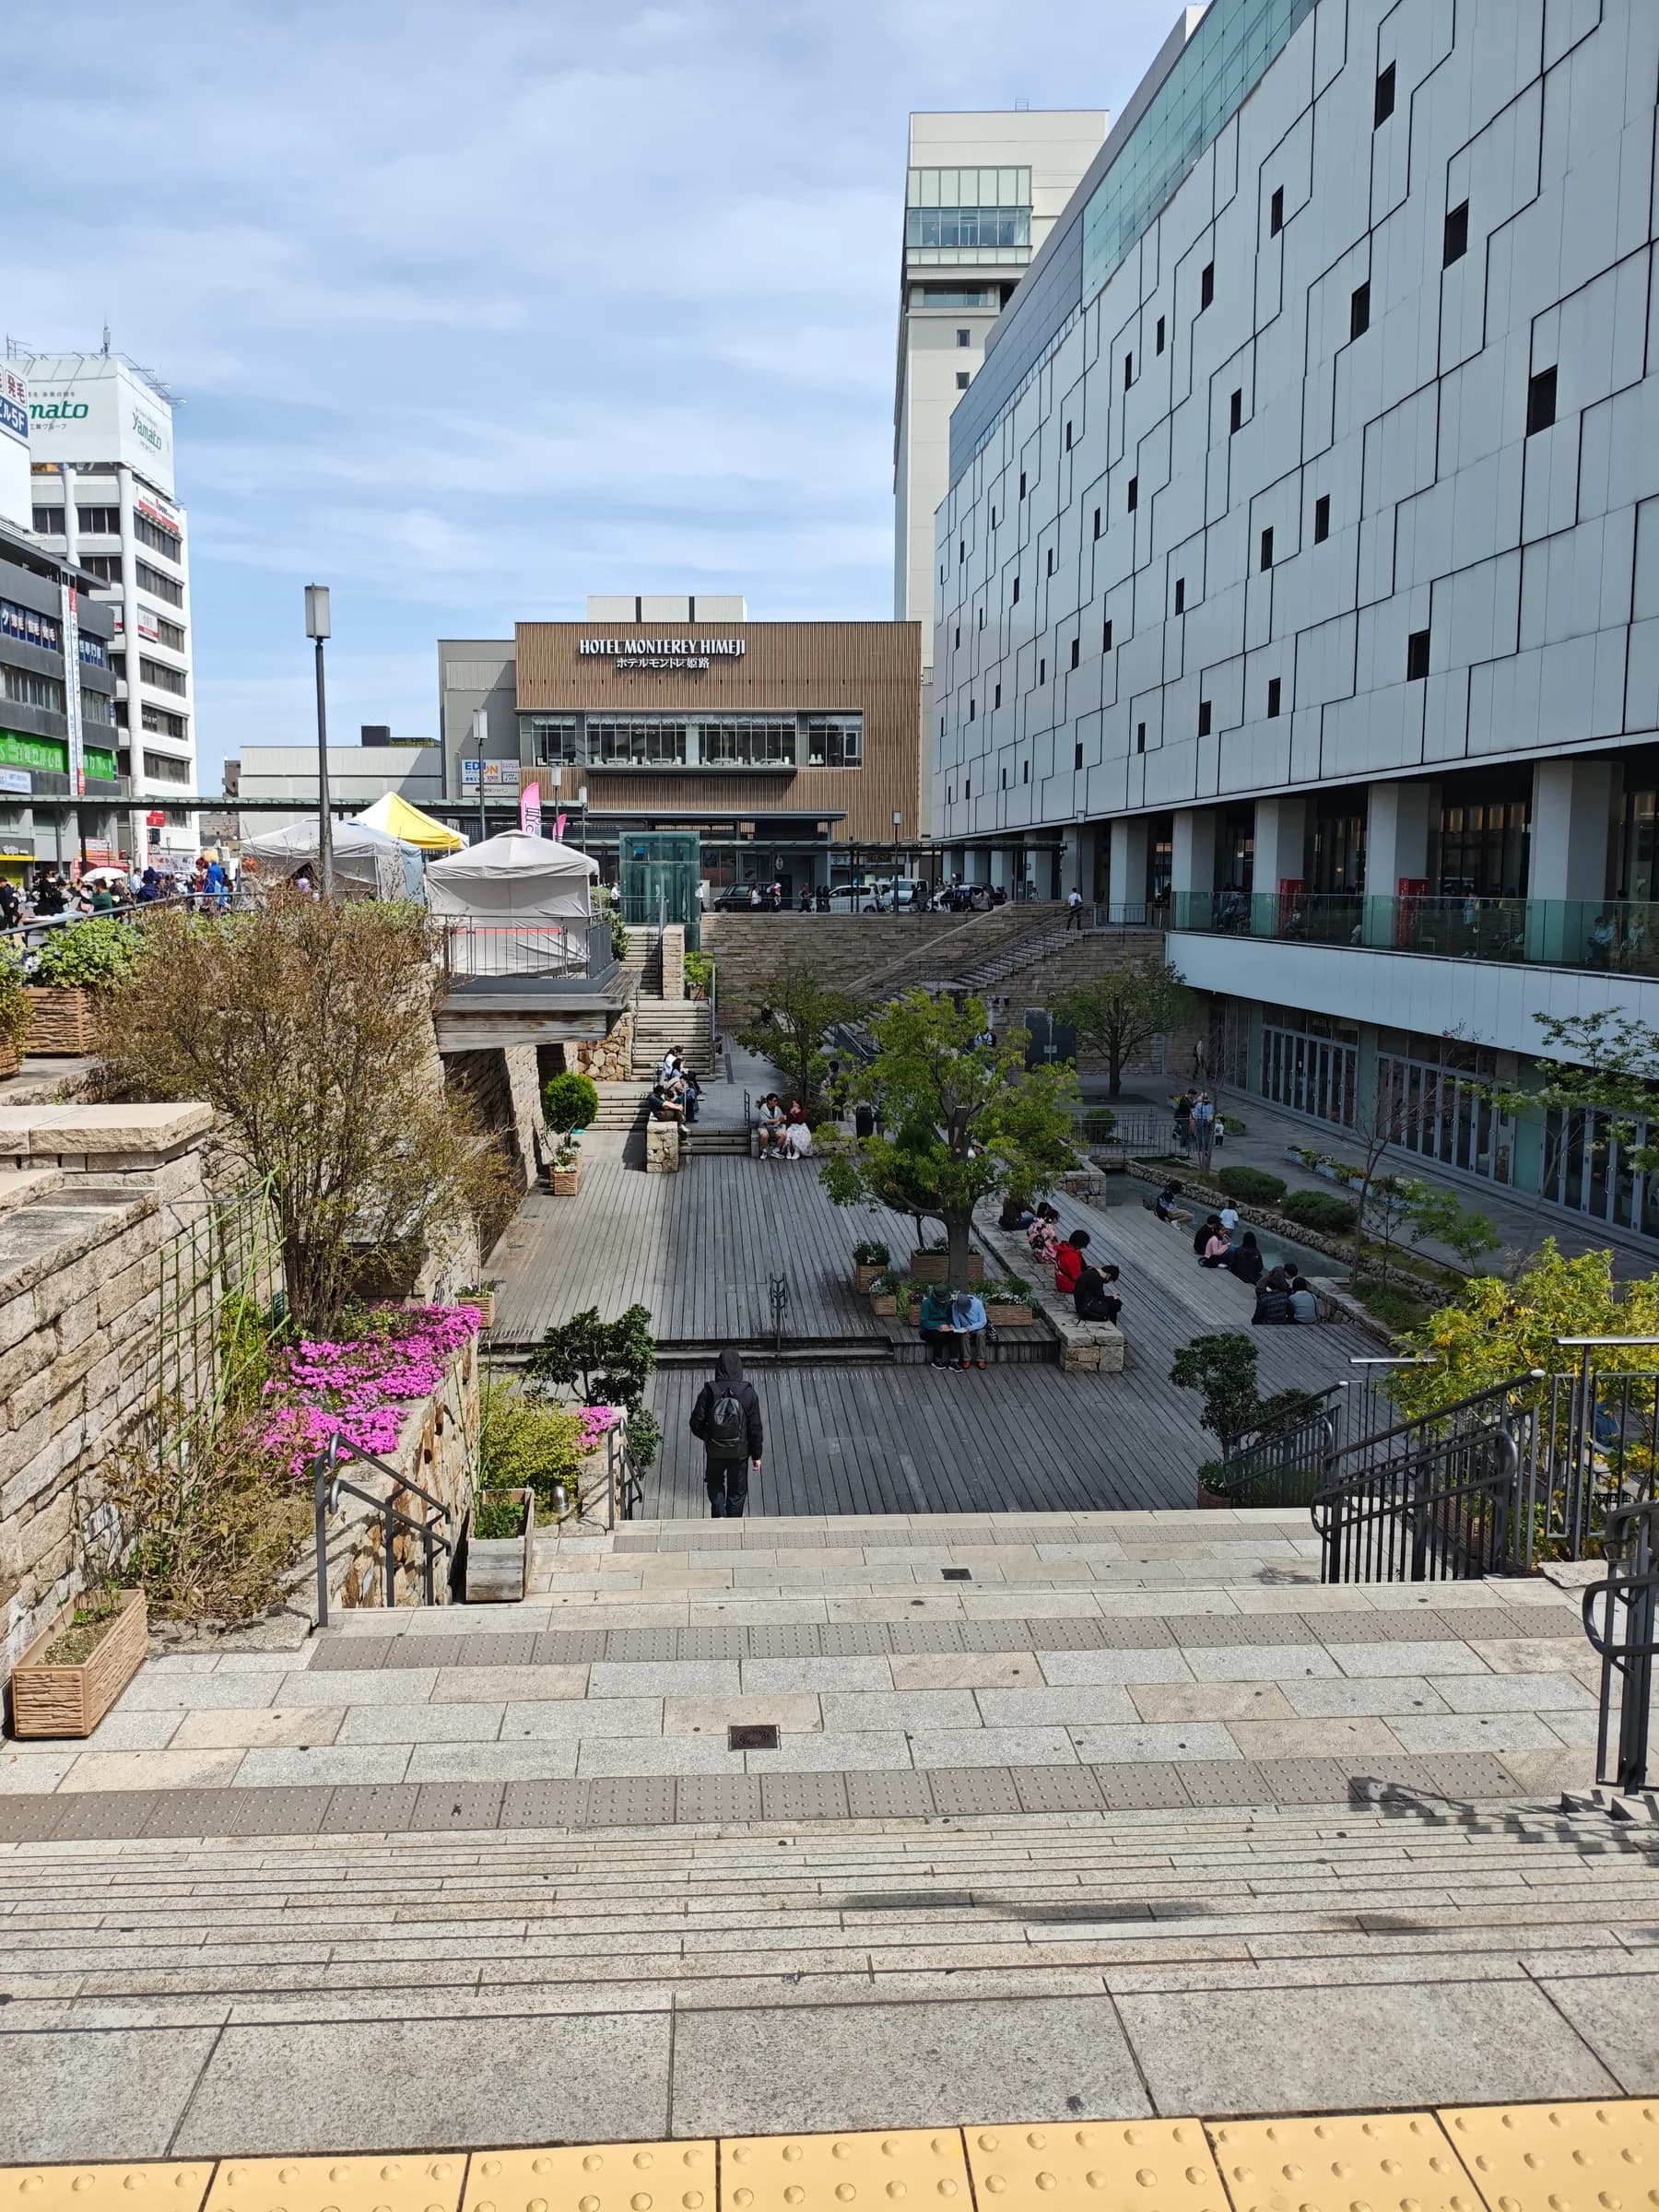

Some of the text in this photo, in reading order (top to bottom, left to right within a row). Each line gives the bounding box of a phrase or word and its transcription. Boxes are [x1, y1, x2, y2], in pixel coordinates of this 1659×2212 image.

[29, 400, 88, 419] mato
[132, 412, 162, 451] Yamato
[580, 639, 746, 657] HOTEL MONTEREY HIMEJI
[616, 657, 710, 669] ホテルモントレ姫路
